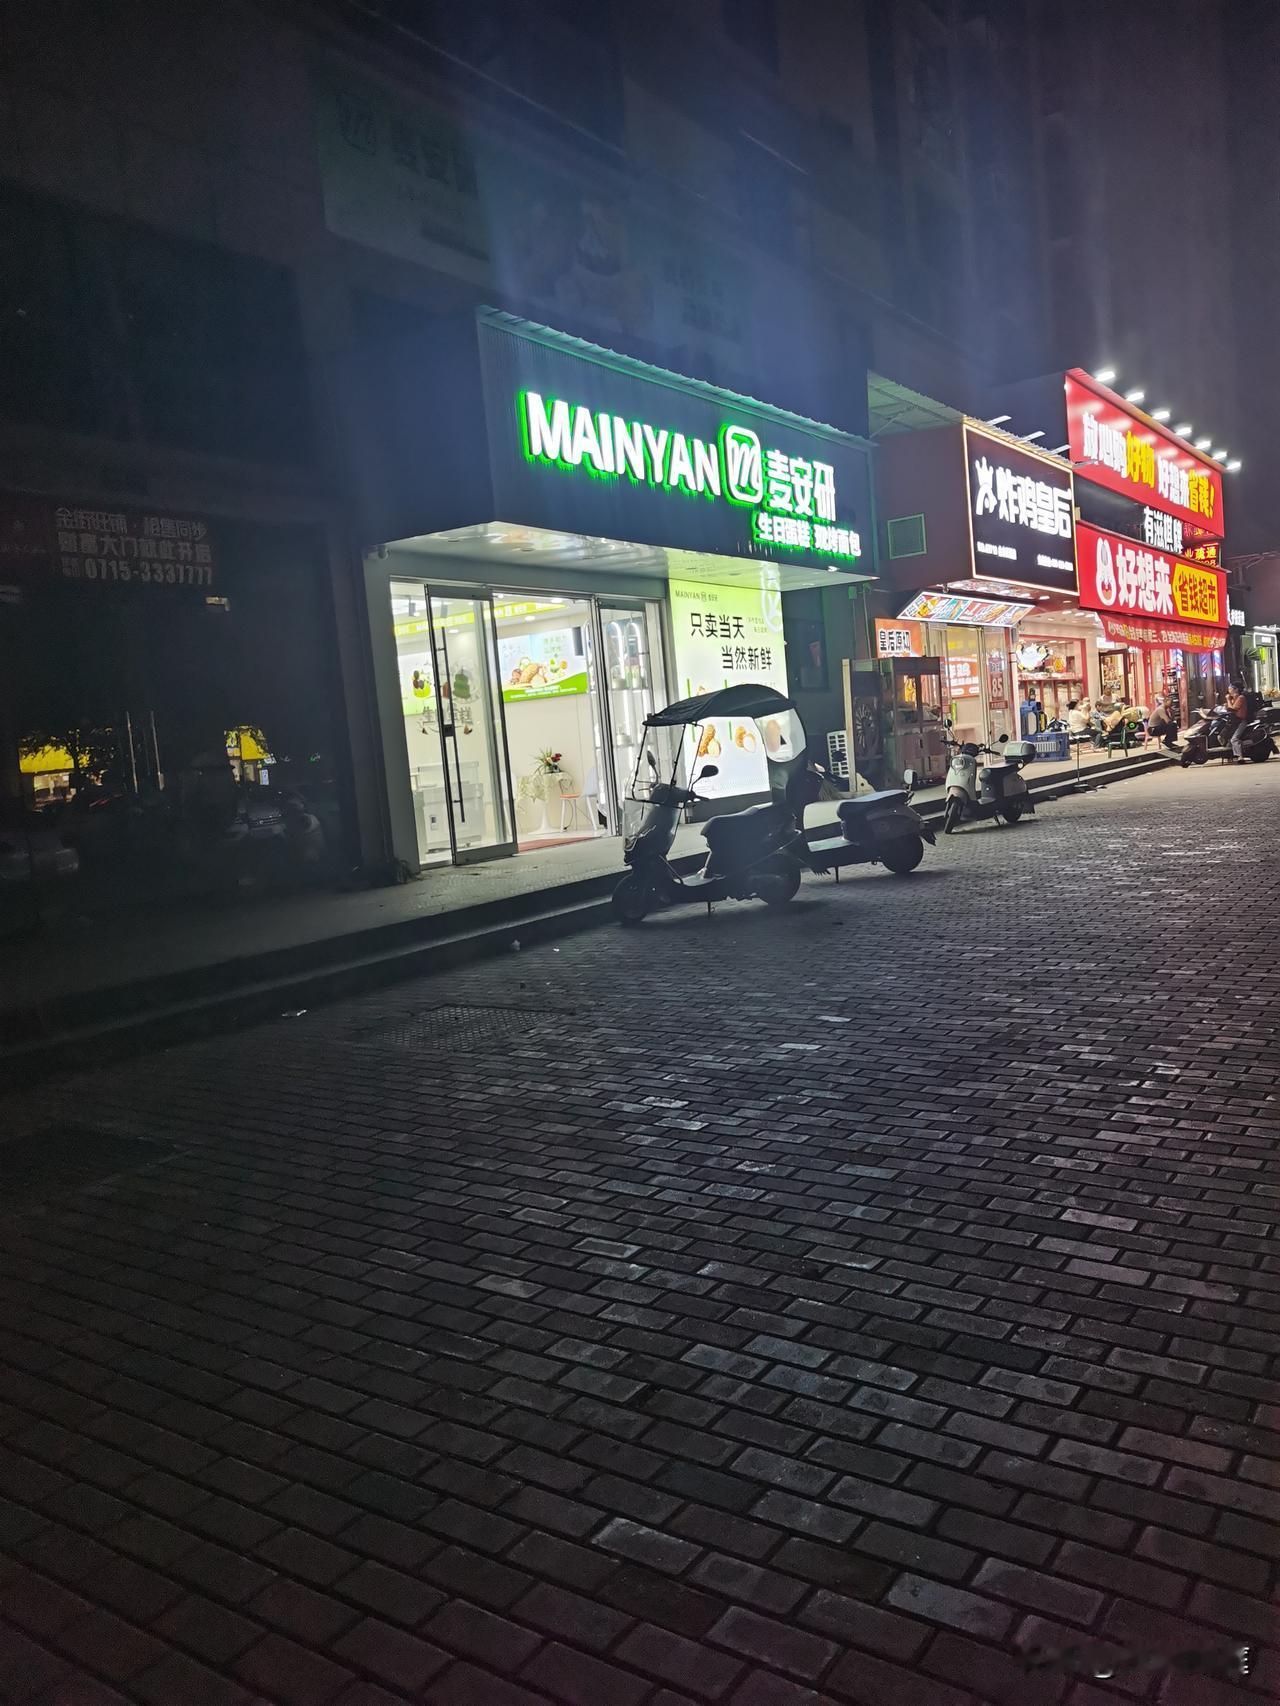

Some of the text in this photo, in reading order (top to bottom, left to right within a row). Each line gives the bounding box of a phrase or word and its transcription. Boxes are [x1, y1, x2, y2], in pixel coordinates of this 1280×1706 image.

[527, 391, 721, 496] MAINYAN
[765, 449, 837, 522] 麦安研
[996, 465, 1073, 539] 炸鸡皇后
[757, 511, 812, 548] 生日蛋糕
[675, 589, 701, 600] MAINYAN
[1116, 543, 1175, 616] 好想来
[690, 612, 745, 639] 只卖当天
[721, 645, 772, 670] 当然新鲜
